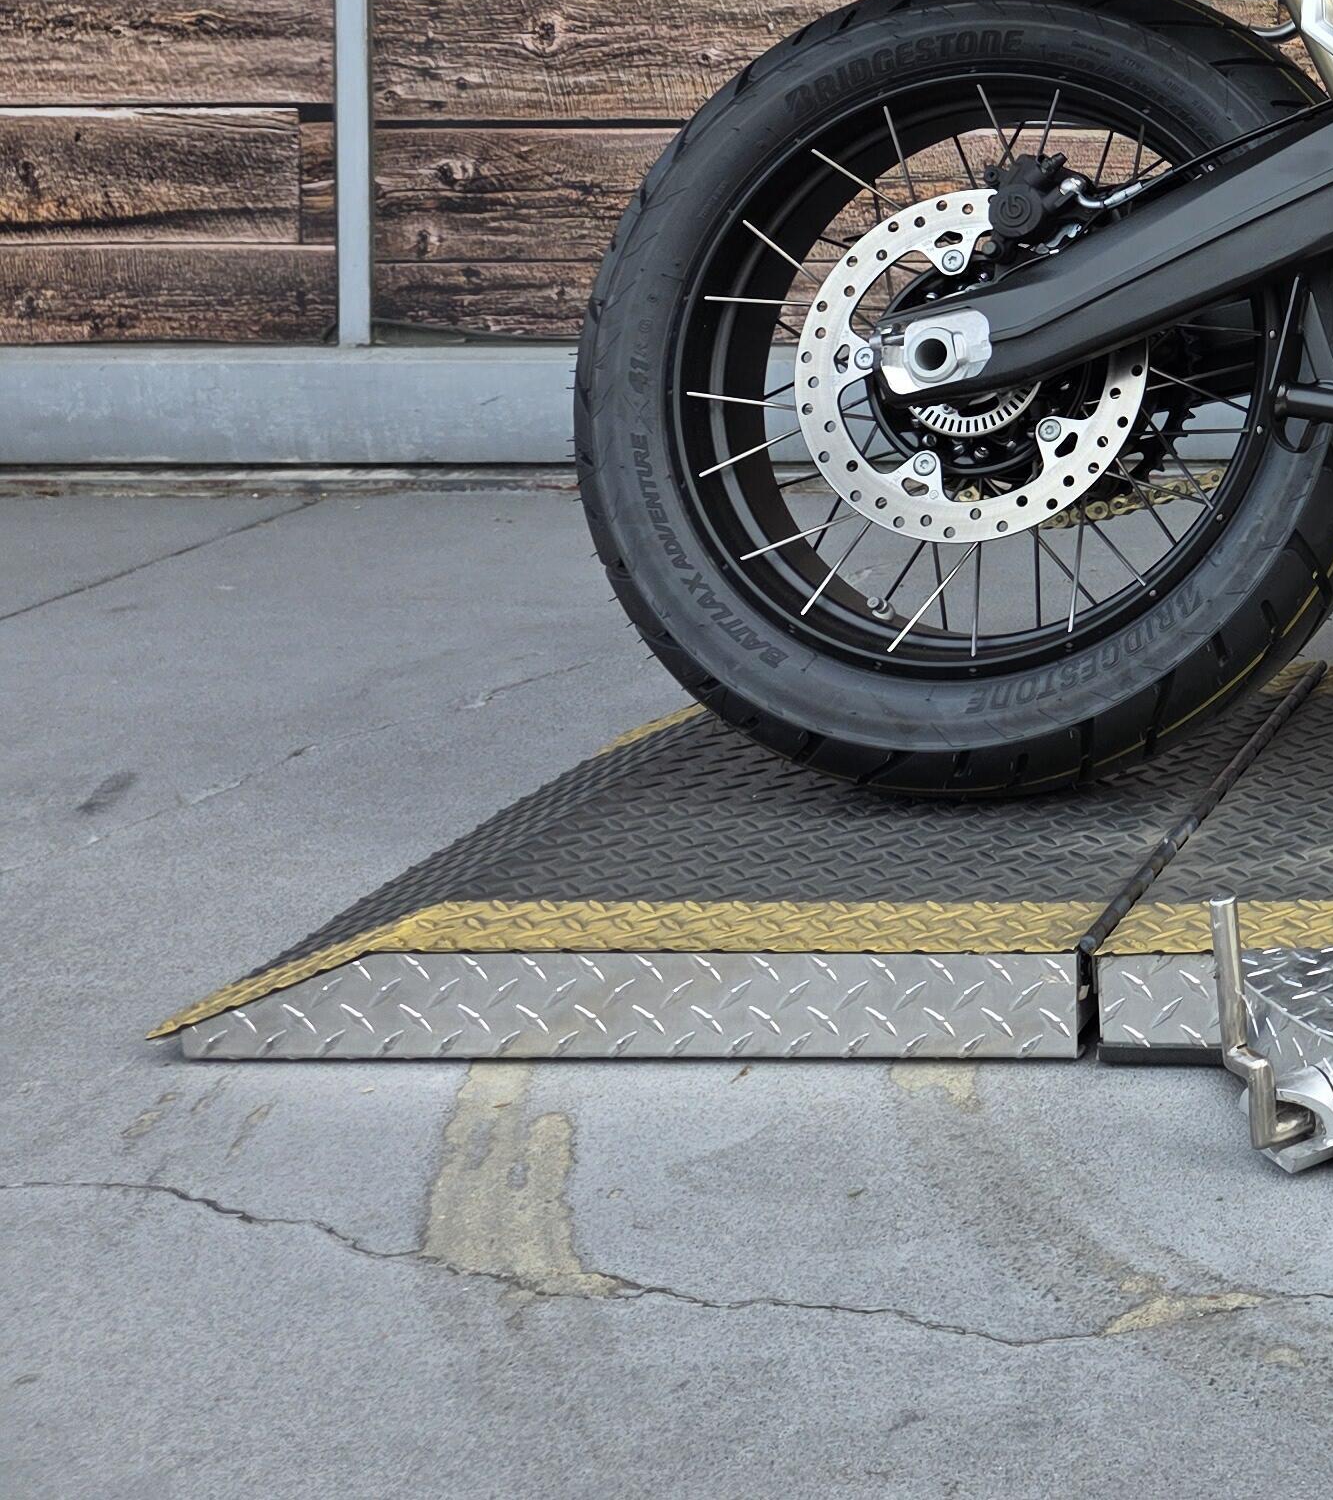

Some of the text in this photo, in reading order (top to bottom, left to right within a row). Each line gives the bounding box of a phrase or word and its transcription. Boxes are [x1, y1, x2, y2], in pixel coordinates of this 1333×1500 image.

[785, 29, 1025, 115] BRIDGESTONE
[629, 433, 693, 576] ADVENTURE
[680, 576, 792, 670] BATTLAX
[964, 586, 1202, 714] BRIDGESTONE
